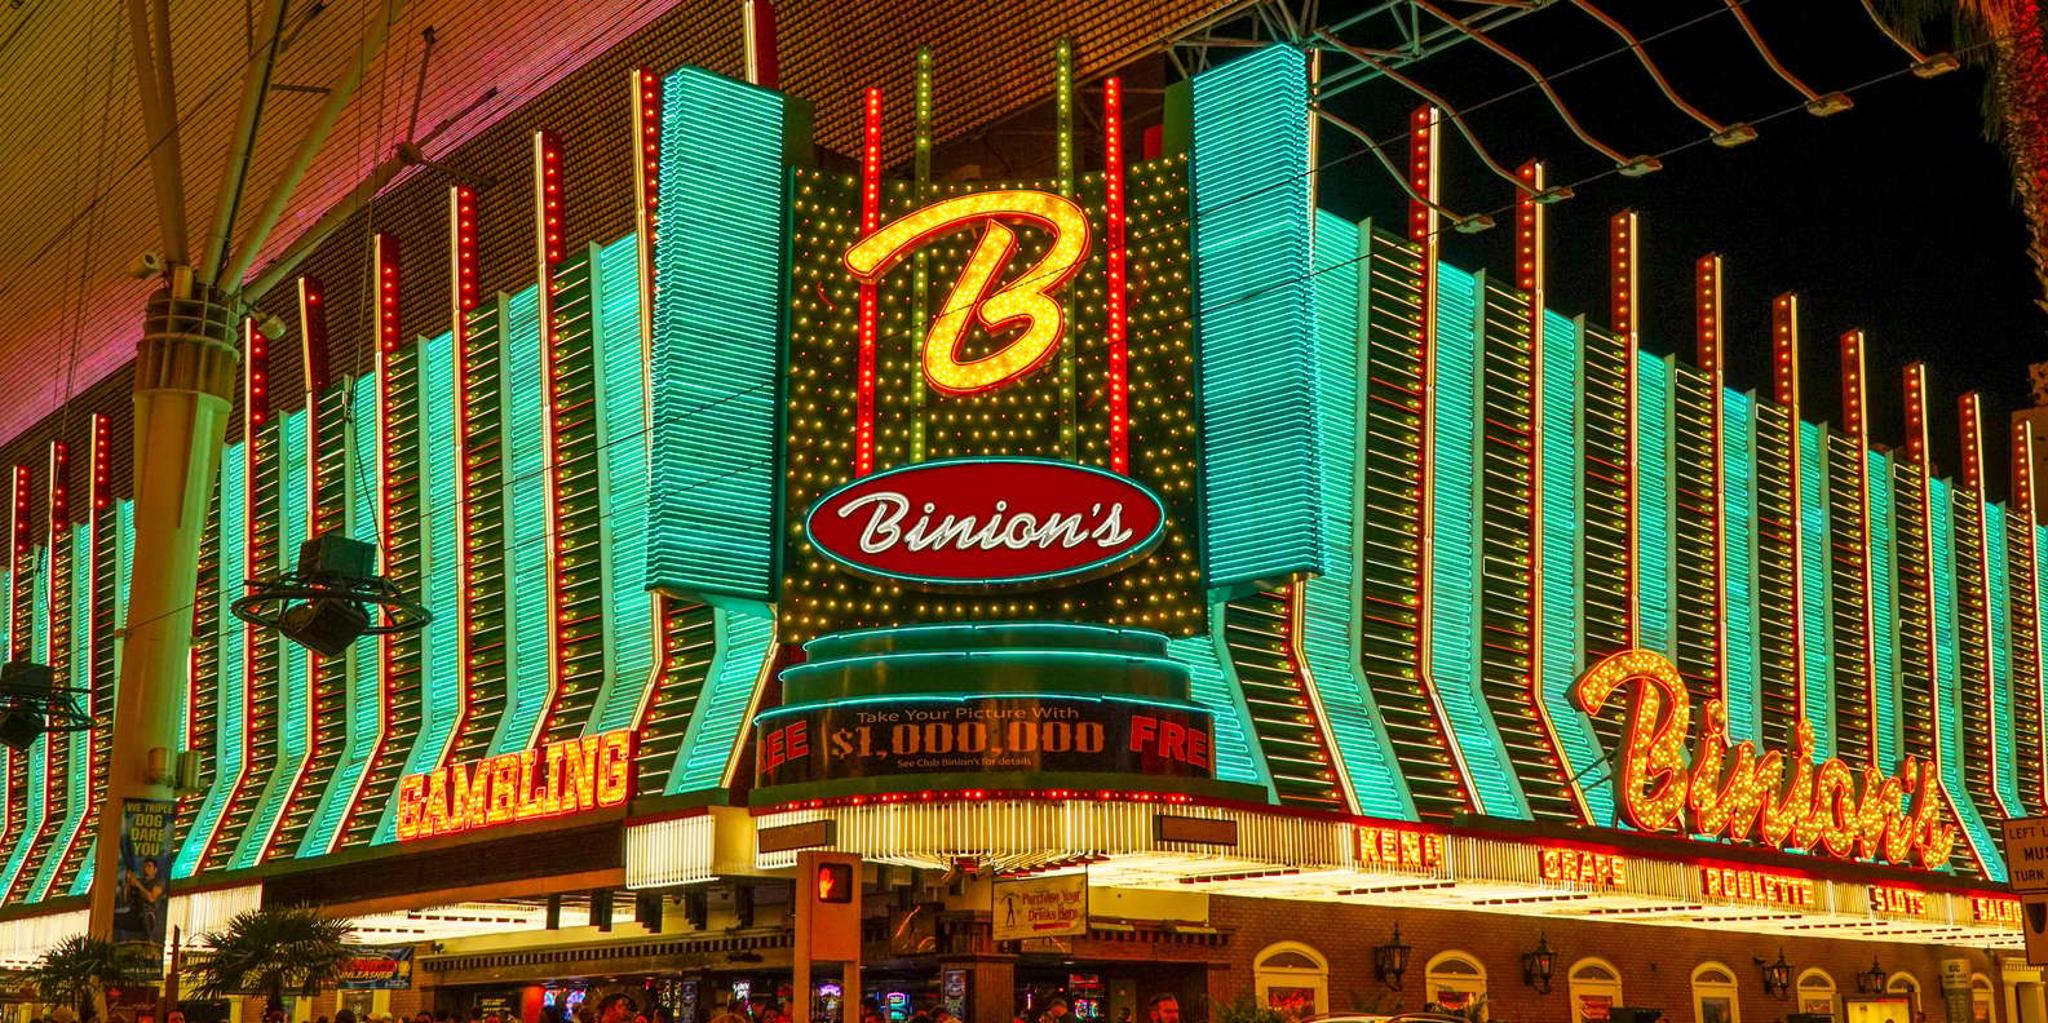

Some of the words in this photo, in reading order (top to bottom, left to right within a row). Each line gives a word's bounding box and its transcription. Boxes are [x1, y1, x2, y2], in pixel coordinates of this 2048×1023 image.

[844, 190, 1093, 395] B
[837, 491, 1132, 553] Binion's
[856, 711, 899, 724] Take
[905, 709, 950, 721] Your
[956, 707, 1026, 720] Picture
[1032, 706, 1080, 719] With
[832, 721, 1105, 759] $1,000,000
[897, 759, 915, 768] See
[917, 757, 939, 768] Club
[942, 757, 979, 767] Binion's
[982, 756, 996, 766] for
[998, 756, 1032, 767] details
[1572, 649, 1954, 869] Binion's
[396, 727, 632, 842] GAMBLING
[127, 803, 143, 812] WE
[144, 803, 174, 814] TRIPLE
[135, 813, 163, 827] DOG
[130, 827, 165, 842] DARE
[2009, 826, 2035, 840] LEFT
[133, 842, 160, 857] YOU
[1360, 827, 1444, 869] KENO
[1544, 847, 1627, 888] CRAPS
[2014, 868, 2045, 882] TURN
[1706, 867, 1814, 905] ROULETTE
[1874, 887, 1926, 915] SLOTS
